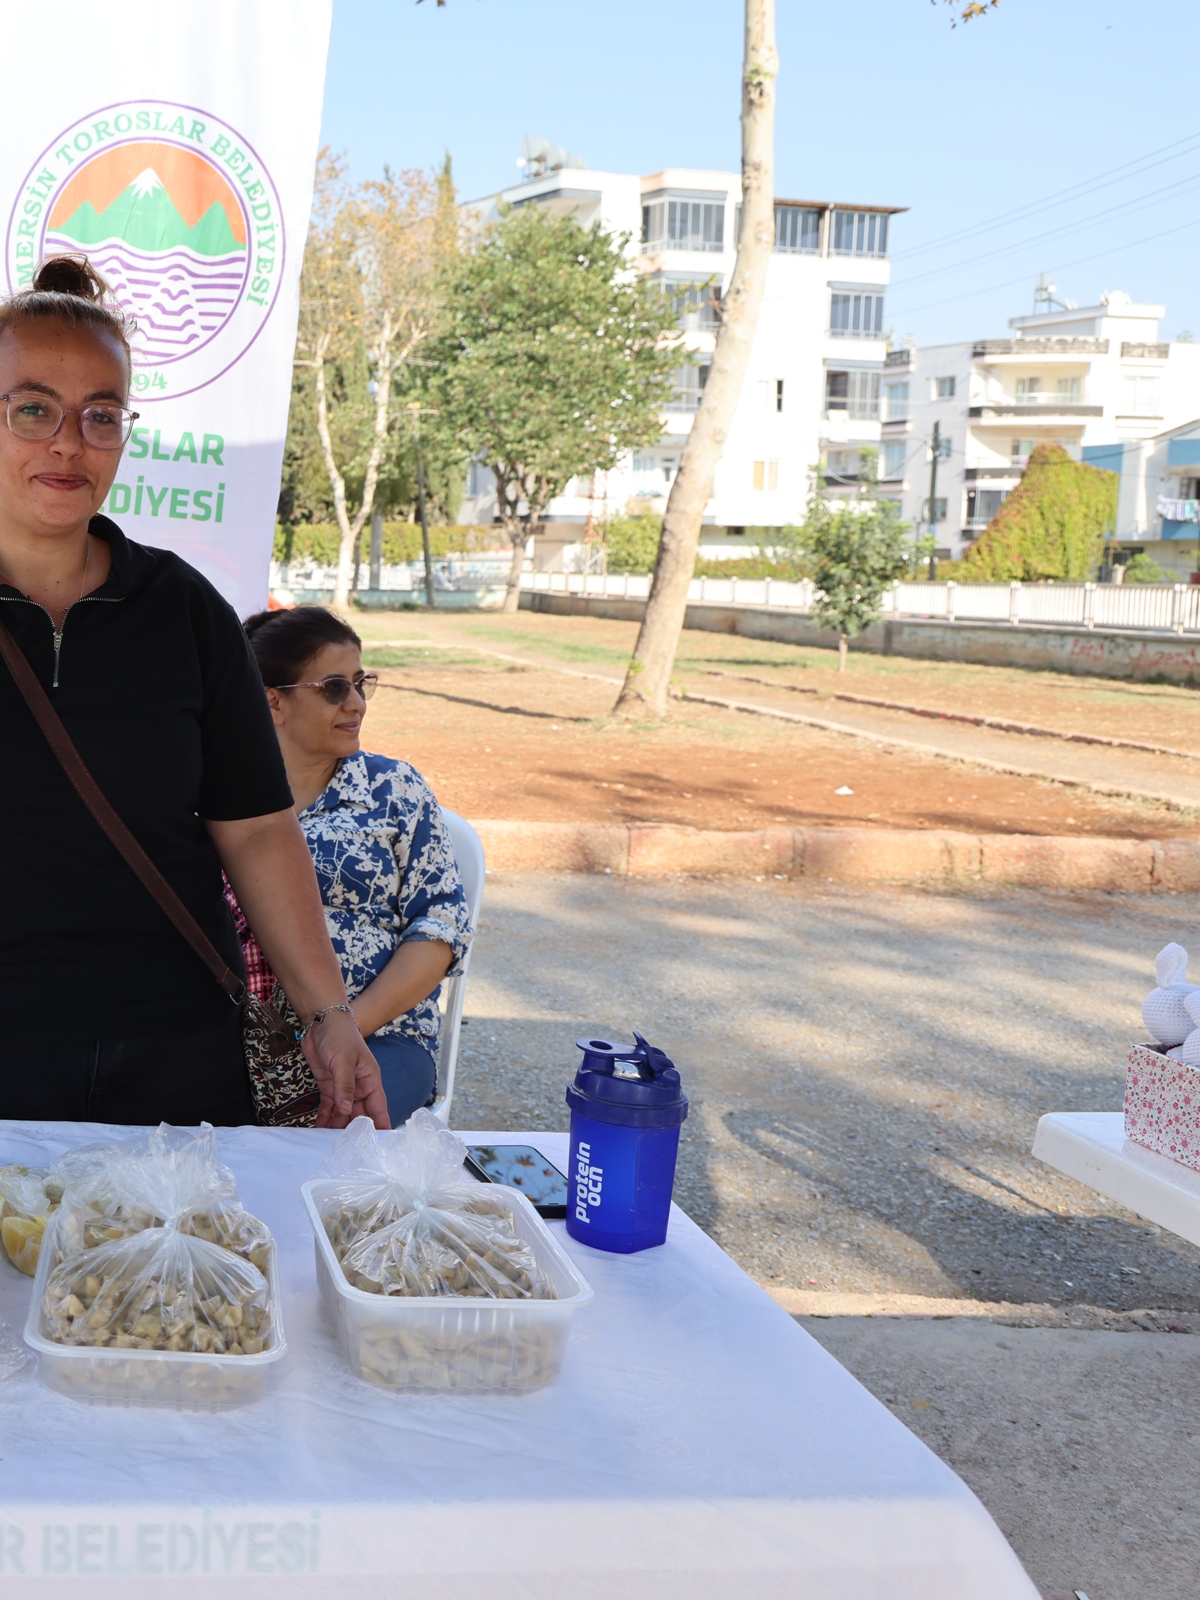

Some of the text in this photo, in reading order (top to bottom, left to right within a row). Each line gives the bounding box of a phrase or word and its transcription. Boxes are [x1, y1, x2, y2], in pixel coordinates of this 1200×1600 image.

[15, 111, 279, 307] MERSİN TOROSLAR BELEDİYESİ
[131, 371, 168, 392] 94
[128, 427, 225, 466] SLAR
[98, 475, 226, 523] DİYESİ
[575, 1141, 591, 1224] protein
[587, 1165, 604, 1207] ocn
[41, 1508, 323, 1575] BELEDİYESİ
